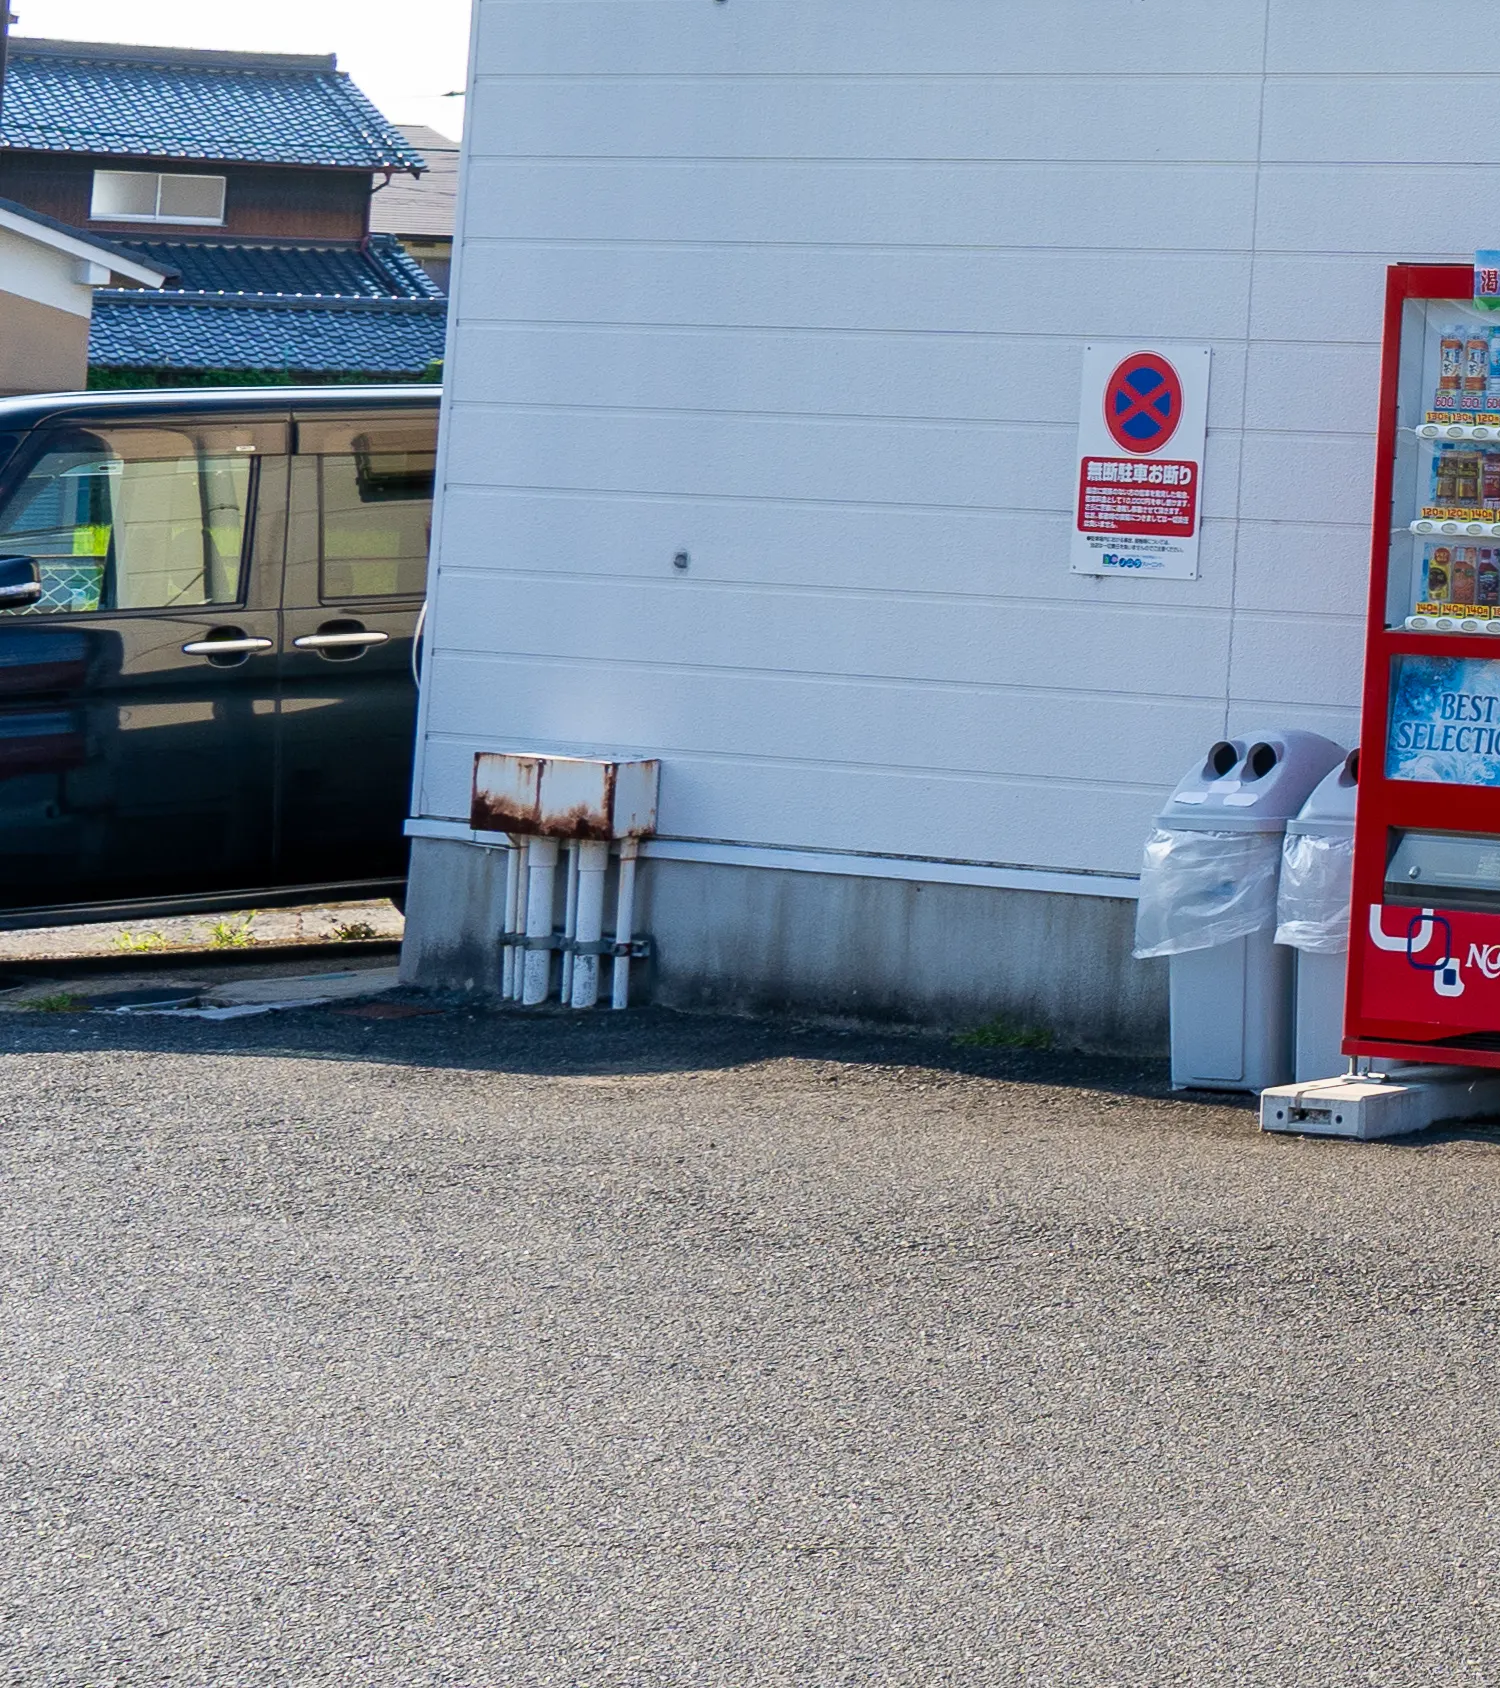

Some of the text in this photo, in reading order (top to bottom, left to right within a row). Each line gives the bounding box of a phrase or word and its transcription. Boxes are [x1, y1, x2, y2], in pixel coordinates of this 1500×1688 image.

[1087, 461, 1191, 485] 無断駐車お断り
[1440, 693, 1498, 723] BEST
